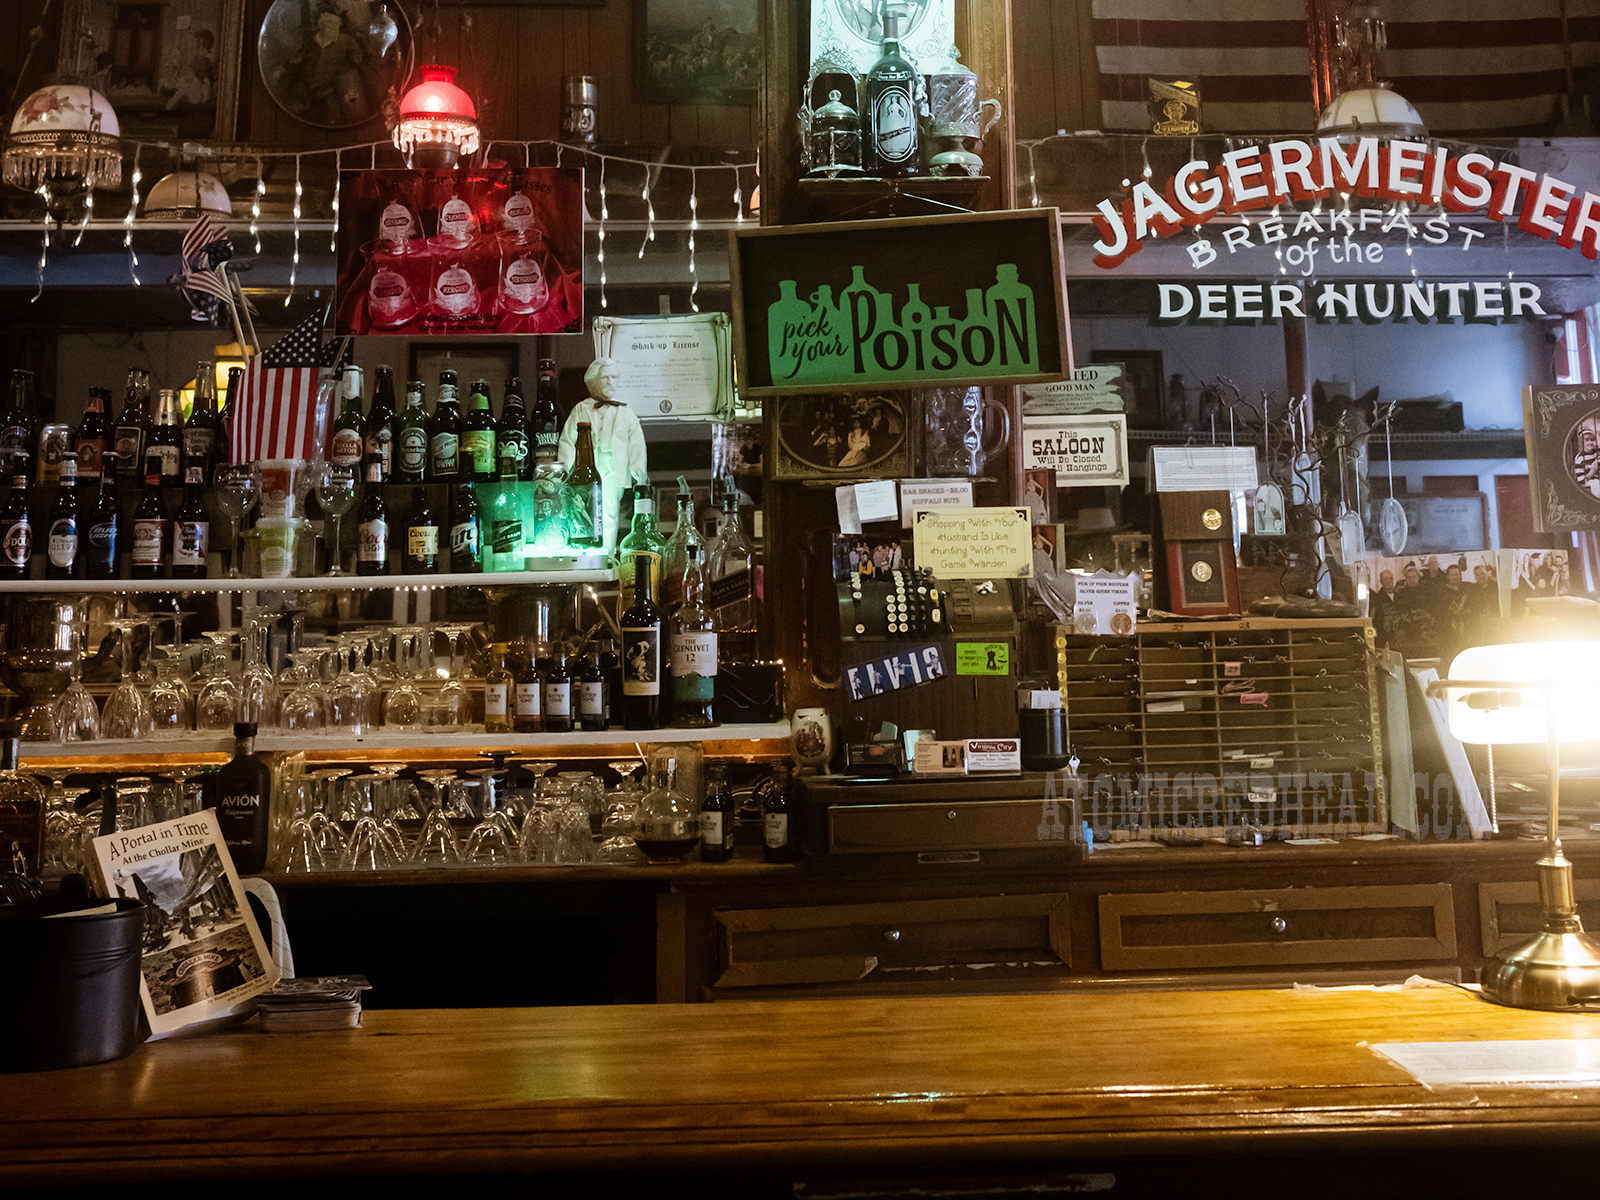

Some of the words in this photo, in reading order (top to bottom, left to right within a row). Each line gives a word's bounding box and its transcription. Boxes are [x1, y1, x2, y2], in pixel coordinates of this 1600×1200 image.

[1093, 137, 1600, 257] JÄGERMEISTER
[1186, 209, 1485, 270] BREAKFAST
[1286, 238, 1319, 276] of
[1328, 236, 1384, 264] the
[1158, 282, 1307, 318] DEER
[1317, 281, 1546, 319] HUNTER
[779, 306, 832, 357] pick
[631, 341, 668, 350] Shack-up
[672, 341, 700, 349] License
[783, 334, 849, 379] your
[1074, 370, 1098, 380] TED
[1074, 383, 1096, 391] MAN
[1058, 430, 1078, 438] This
[1032, 437, 1105, 456] SALOON
[1037, 456, 1055, 464] Will
[1072, 454, 1101, 463] Closed
[1066, 463, 1107, 473] Hangings
[918, 487, 945, 495] SNACKS
[927, 519, 966, 531] Shopping
[967, 518, 992, 527] With
[993, 518, 1018, 527] Your
[937, 532, 978, 541] Husband
[981, 531, 989, 540] Is
[991, 531, 1009, 540] Like
[930, 546, 968, 559] Hunting
[969, 545, 994, 554] With
[996, 545, 1017, 554] The
[940, 559, 966, 569] Game
[968, 558, 1008, 568] Warden
[673, 644, 710, 652] GLENLIVET
[685, 653, 696, 662] 12
[846, 646, 944, 702] ELVIS
[970, 742, 996, 751] Virginia
[997, 742, 1013, 751] City
[221, 793, 260, 807] AVIÓN
[110, 841, 121, 861] A
[121, 830, 157, 853] Portal
[159, 828, 172, 839] in
[174, 820, 210, 838] Time
[122, 856, 132, 865] At
[133, 852, 148, 862] the
[148, 845, 180, 859] Chollar
[181, 837, 205, 850] Mine
